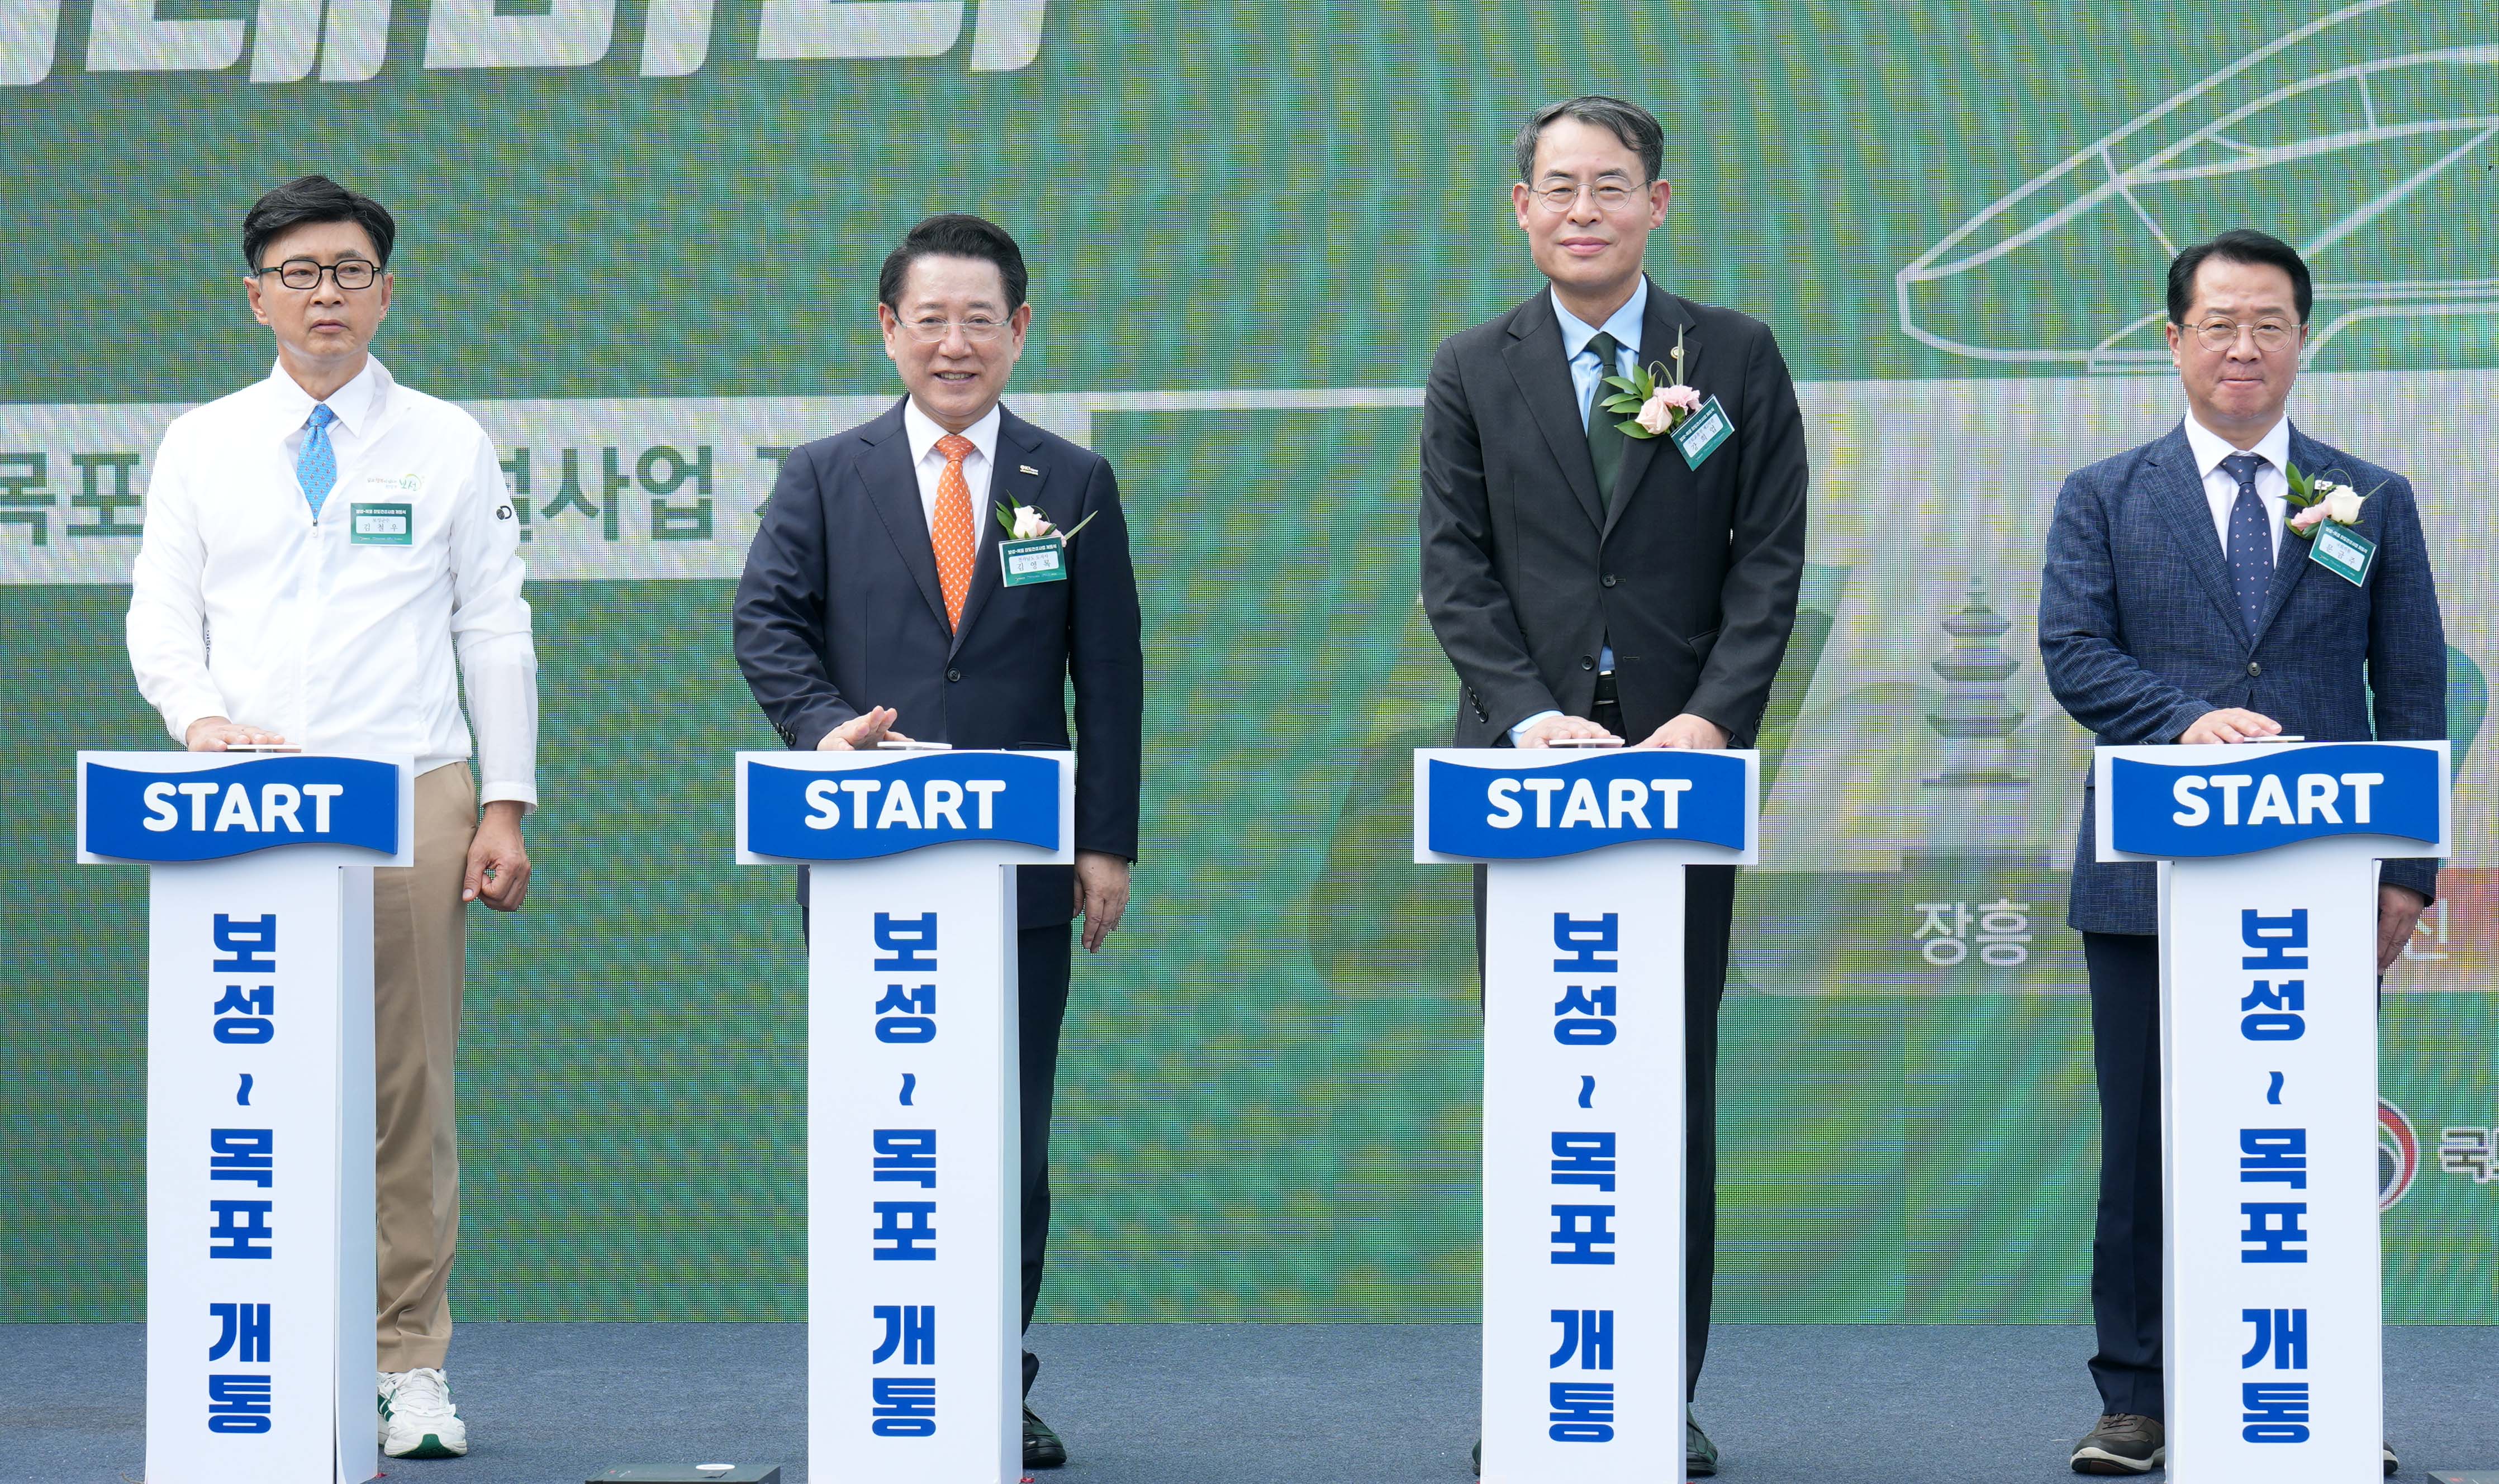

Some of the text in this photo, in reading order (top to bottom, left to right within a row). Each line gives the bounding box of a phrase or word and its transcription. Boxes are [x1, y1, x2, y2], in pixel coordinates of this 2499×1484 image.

[144, 782, 343, 833] START
[805, 780, 1006, 830] START
[1487, 778, 1692, 829] START
[2173, 773, 2384, 826] START
[214, 914, 275, 1044] 보성
[875, 913, 937, 1043] 보성
[1554, 914, 1617, 1045] 보성
[1913, 898, 2032, 965] 장흥
[2241, 910, 2308, 1040] 보성
[211, 1129, 272, 1259] 목포
[874, 1130, 935, 1261] 목포
[1551, 1133, 1615, 1264] 목포
[2240, 1129, 2307, 1263] 목포
[209, 1304, 270, 1433] 개통
[873, 1306, 935, 1437] 개통
[1549, 1310, 1613, 1442] 개통
[2243, 1309, 2309, 1443] 개통
